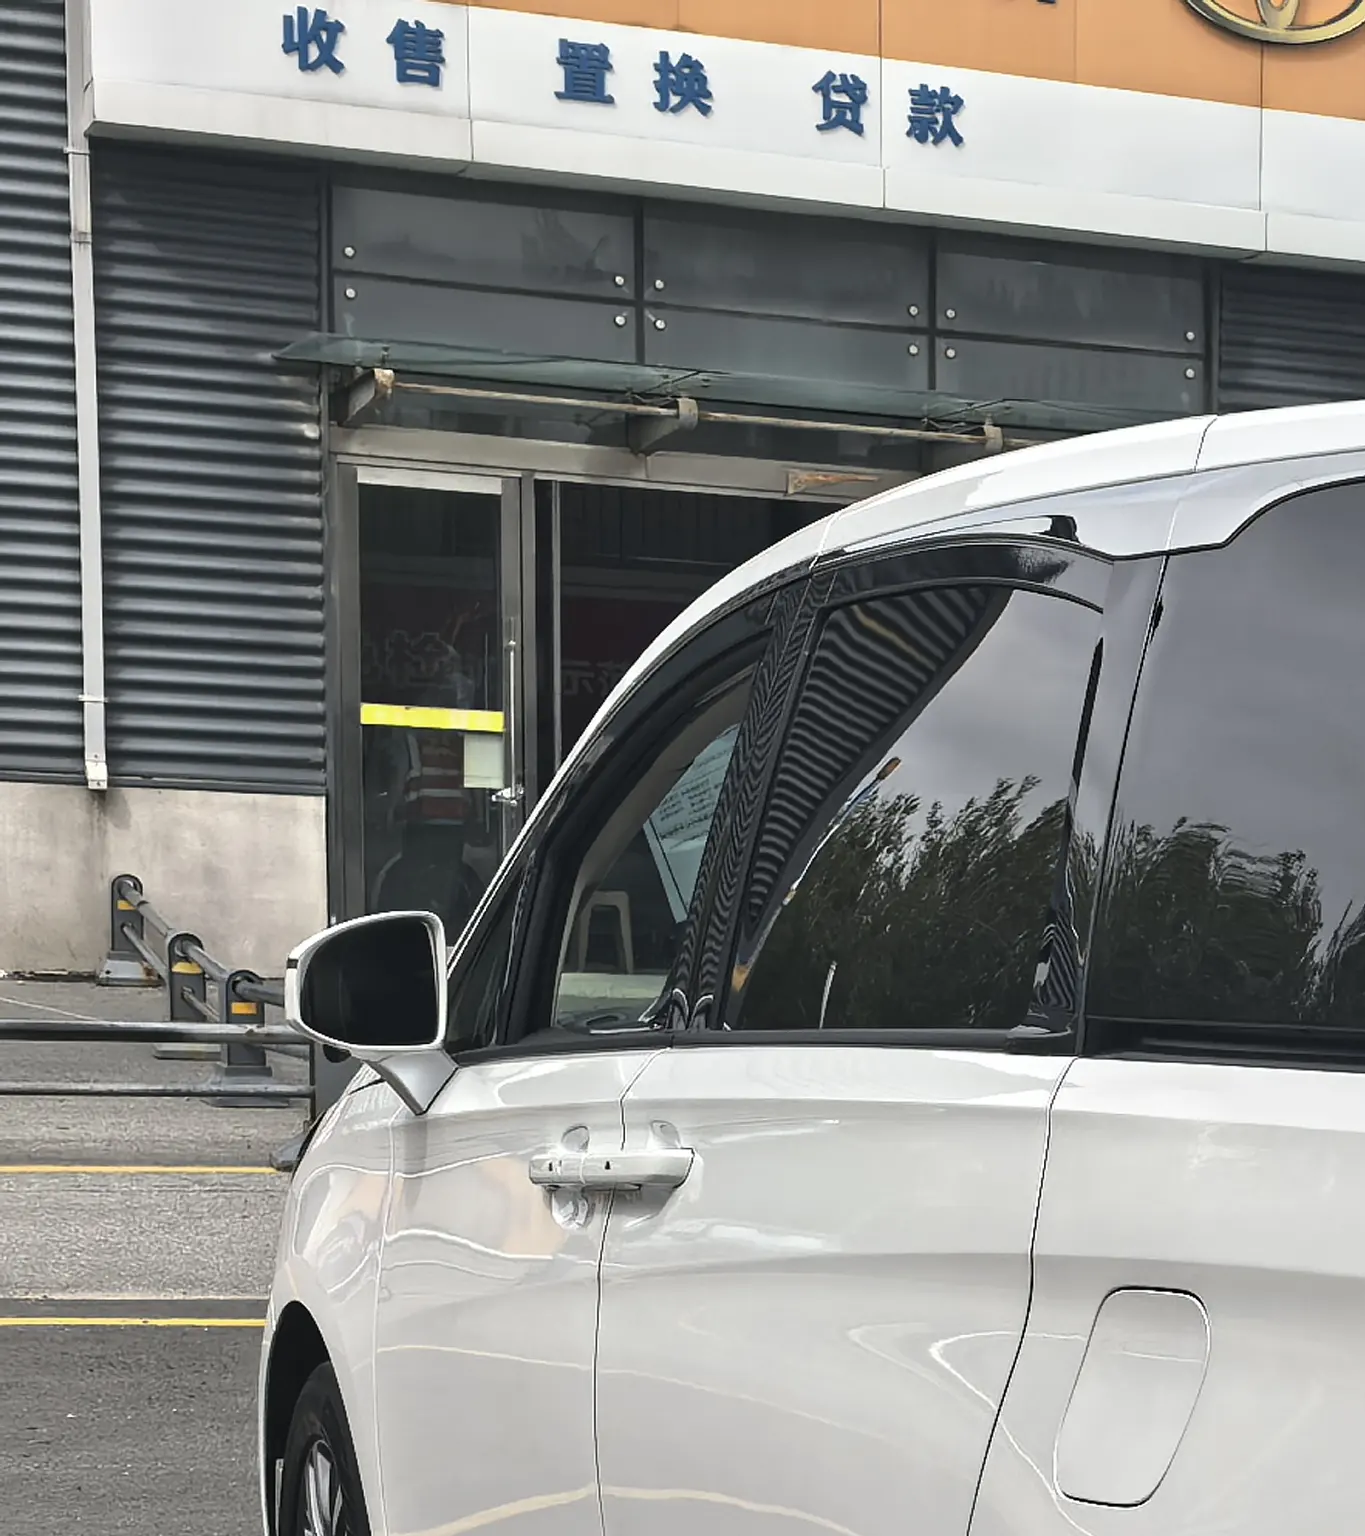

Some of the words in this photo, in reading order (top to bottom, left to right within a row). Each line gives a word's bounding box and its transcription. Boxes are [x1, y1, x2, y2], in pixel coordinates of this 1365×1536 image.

[281, 6, 446, 87] 收售
[554, 38, 714, 117] 置换
[811, 70, 965, 147] 贷款
